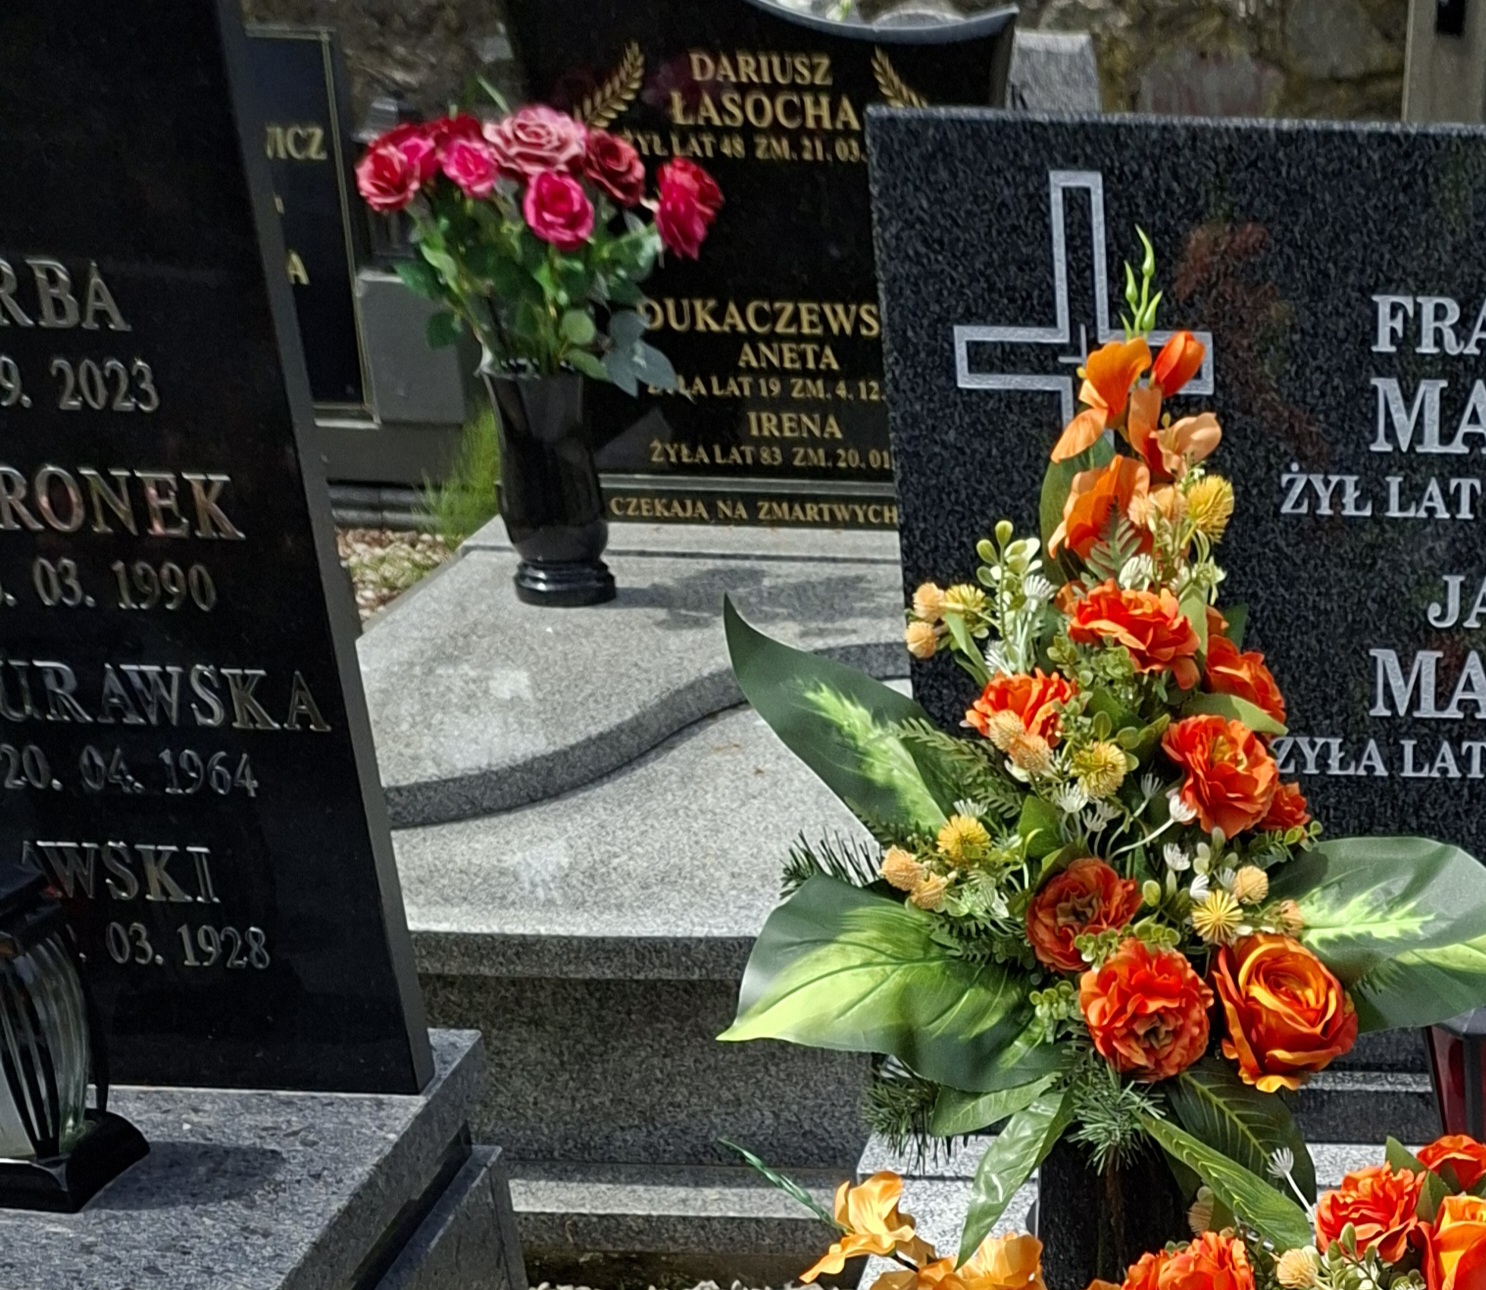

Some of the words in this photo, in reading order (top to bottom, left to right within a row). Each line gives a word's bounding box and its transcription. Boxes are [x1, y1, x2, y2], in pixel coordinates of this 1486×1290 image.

[689, 51, 833, 86] DARIUSZ
[670, 90, 861, 131] ŁASOCHA
[671, 132, 716, 158] LAT
[753, 135, 798, 161] ZM.
[801, 138, 833, 164] 21.
[737, 342, 840, 371] ANETA
[51, 356, 160, 413] 2023
[711, 376, 753, 397] LAT
[759, 377, 781, 397] 19
[791, 378, 832, 399] ZM.
[835, 380, 854, 400] 4.
[858, 380, 886, 401] 12.
[748, 411, 843, 439] IRENA
[650, 438, 711, 464] ŻYŁA
[714, 444, 754, 465] LAT
[760, 446, 783, 466] 83
[793, 448, 833, 468] ZM.
[836, 449, 866, 469] 20.
[0, 463, 247, 540] RONEK
[1280, 462, 1372, 516] ŻYŁ
[1384, 475, 1482, 520] LAT
[717, 500, 748, 520] NA
[757, 501, 898, 524] ZMARTWYCH
[33, 556, 95, 607] 03.
[111, 560, 217, 612] 1990
[0, 659, 332, 732] URAWSKA
[0, 743, 62, 791] 20.
[79, 745, 145, 794] 04.
[159, 749, 258, 797] 1964
[106, 921, 163, 966] 03.
[177, 924, 271, 969] 1928
